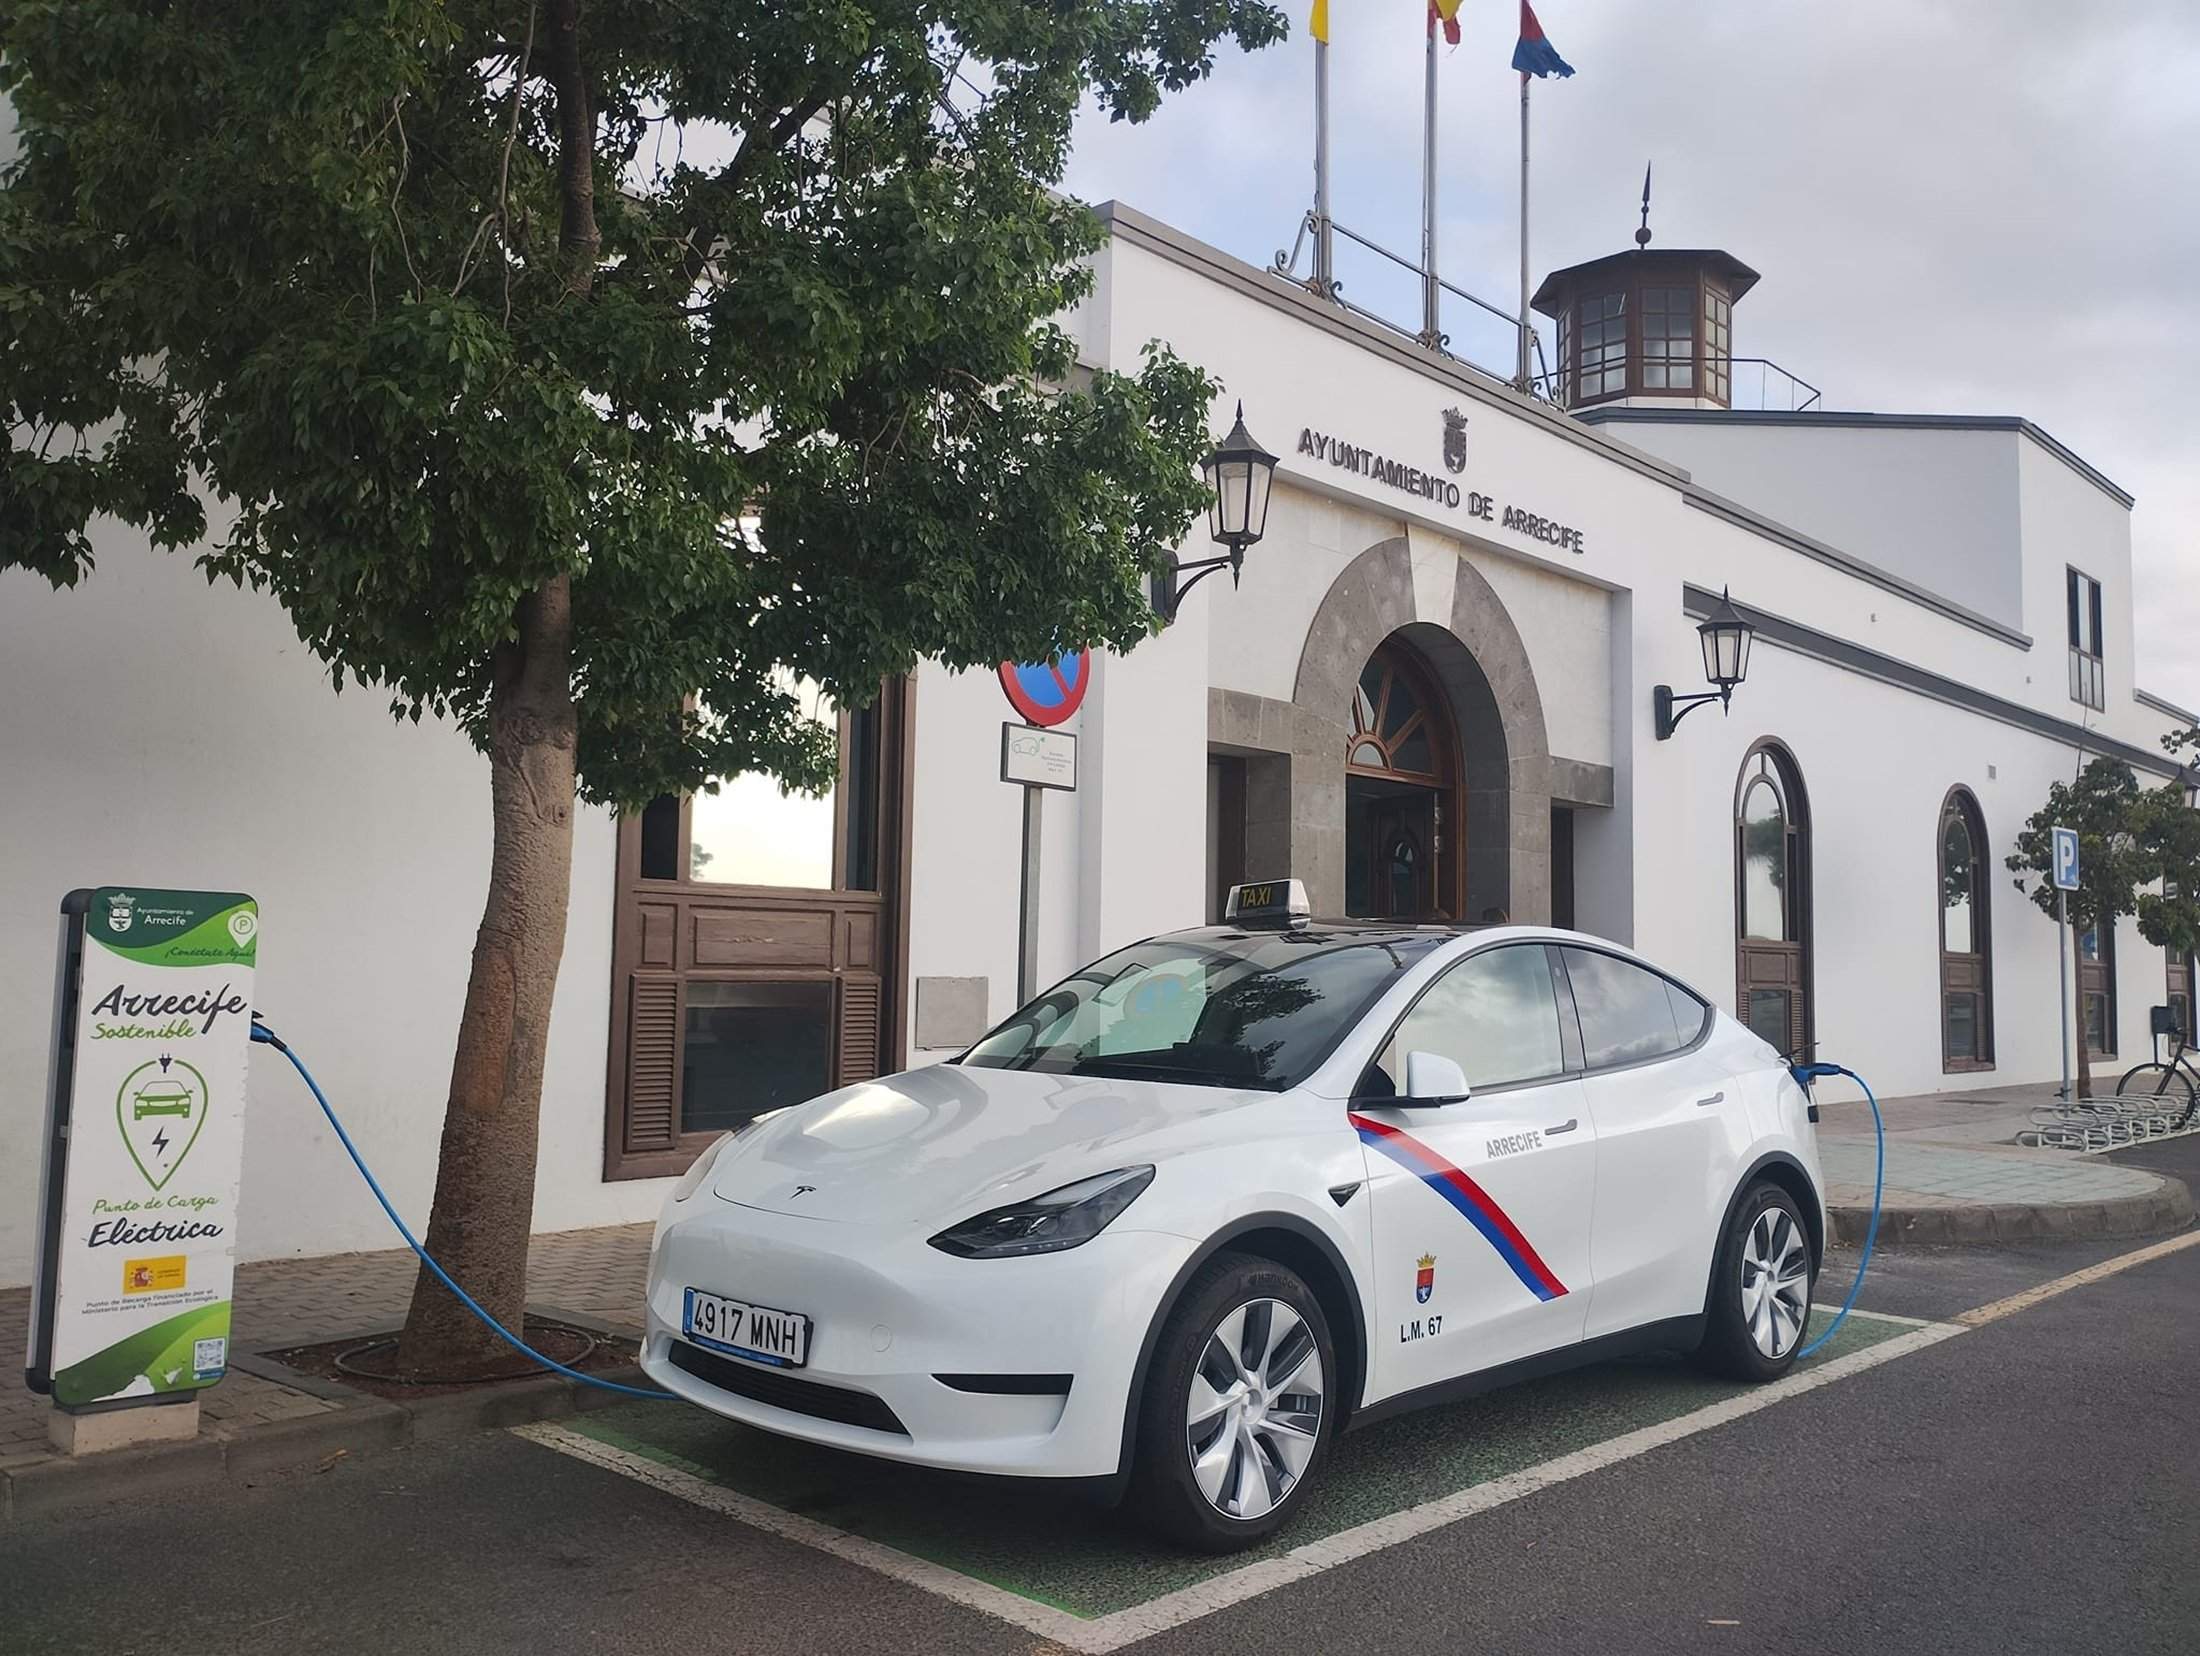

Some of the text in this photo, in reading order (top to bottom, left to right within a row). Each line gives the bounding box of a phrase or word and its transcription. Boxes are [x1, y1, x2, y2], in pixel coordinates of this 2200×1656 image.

[1297, 428, 1584, 554] AYUNTAMIENTO DE ARRECIFE
[2059, 835, 2074, 881] P
[1241, 886, 1272, 908] TAXI
[144, 914, 187, 926] Arrecife
[239, 919, 248, 929] P
[91, 983, 247, 1034] Arrecife
[90, 1018, 197, 1039] Sostenible
[1486, 1130, 1543, 1159] ARRECIFE
[92, 1195, 218, 1215] Punto de Carga
[88, 1217, 223, 1248] Eléctrica
[694, 1299, 743, 1341] 4917
[750, 1313, 796, 1355] MNH
[1400, 1315, 1443, 1344] L.M. 67
